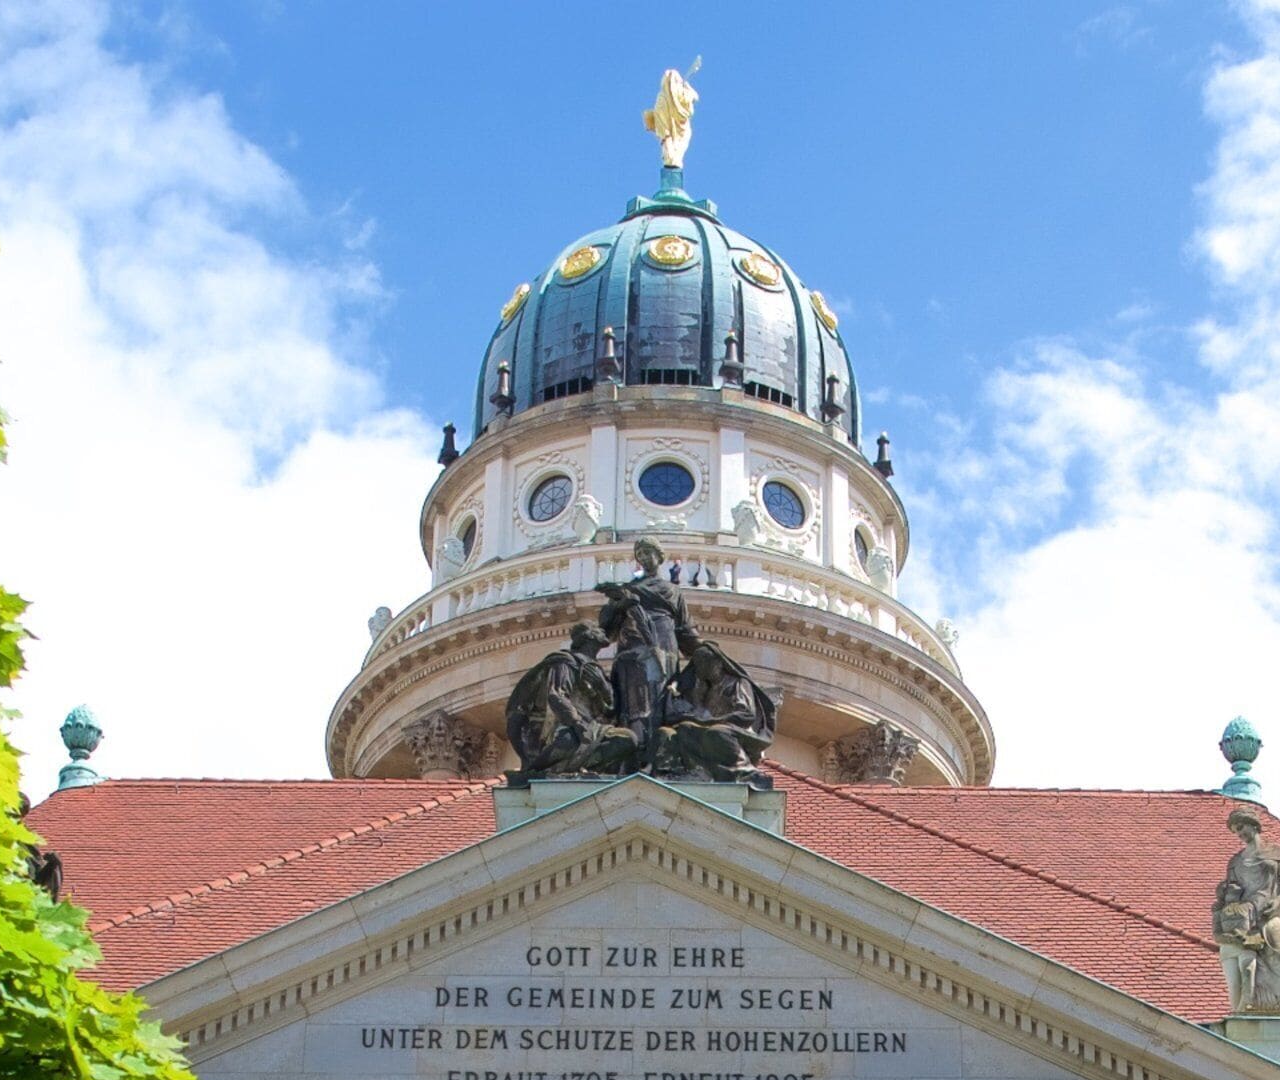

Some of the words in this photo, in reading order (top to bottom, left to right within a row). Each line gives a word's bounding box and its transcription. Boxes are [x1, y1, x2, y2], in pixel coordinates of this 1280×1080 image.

[526, 947, 591, 967] GOTT
[606, 948, 658, 967] ZUR
[673, 948, 745, 968] EHRE
[435, 987, 489, 1007] DER
[507, 987, 655, 1009] GEMEINDE
[670, 989, 723, 1009] ZUM
[740, 989, 833, 1010] SEGEN
[361, 1028, 442, 1049] UNTER
[456, 1029, 508, 1049] DEM
[520, 1030, 634, 1050] SCHUTZE
[646, 1031, 696, 1051] DER
[707, 1031, 907, 1053] HOHENZOLLERN
